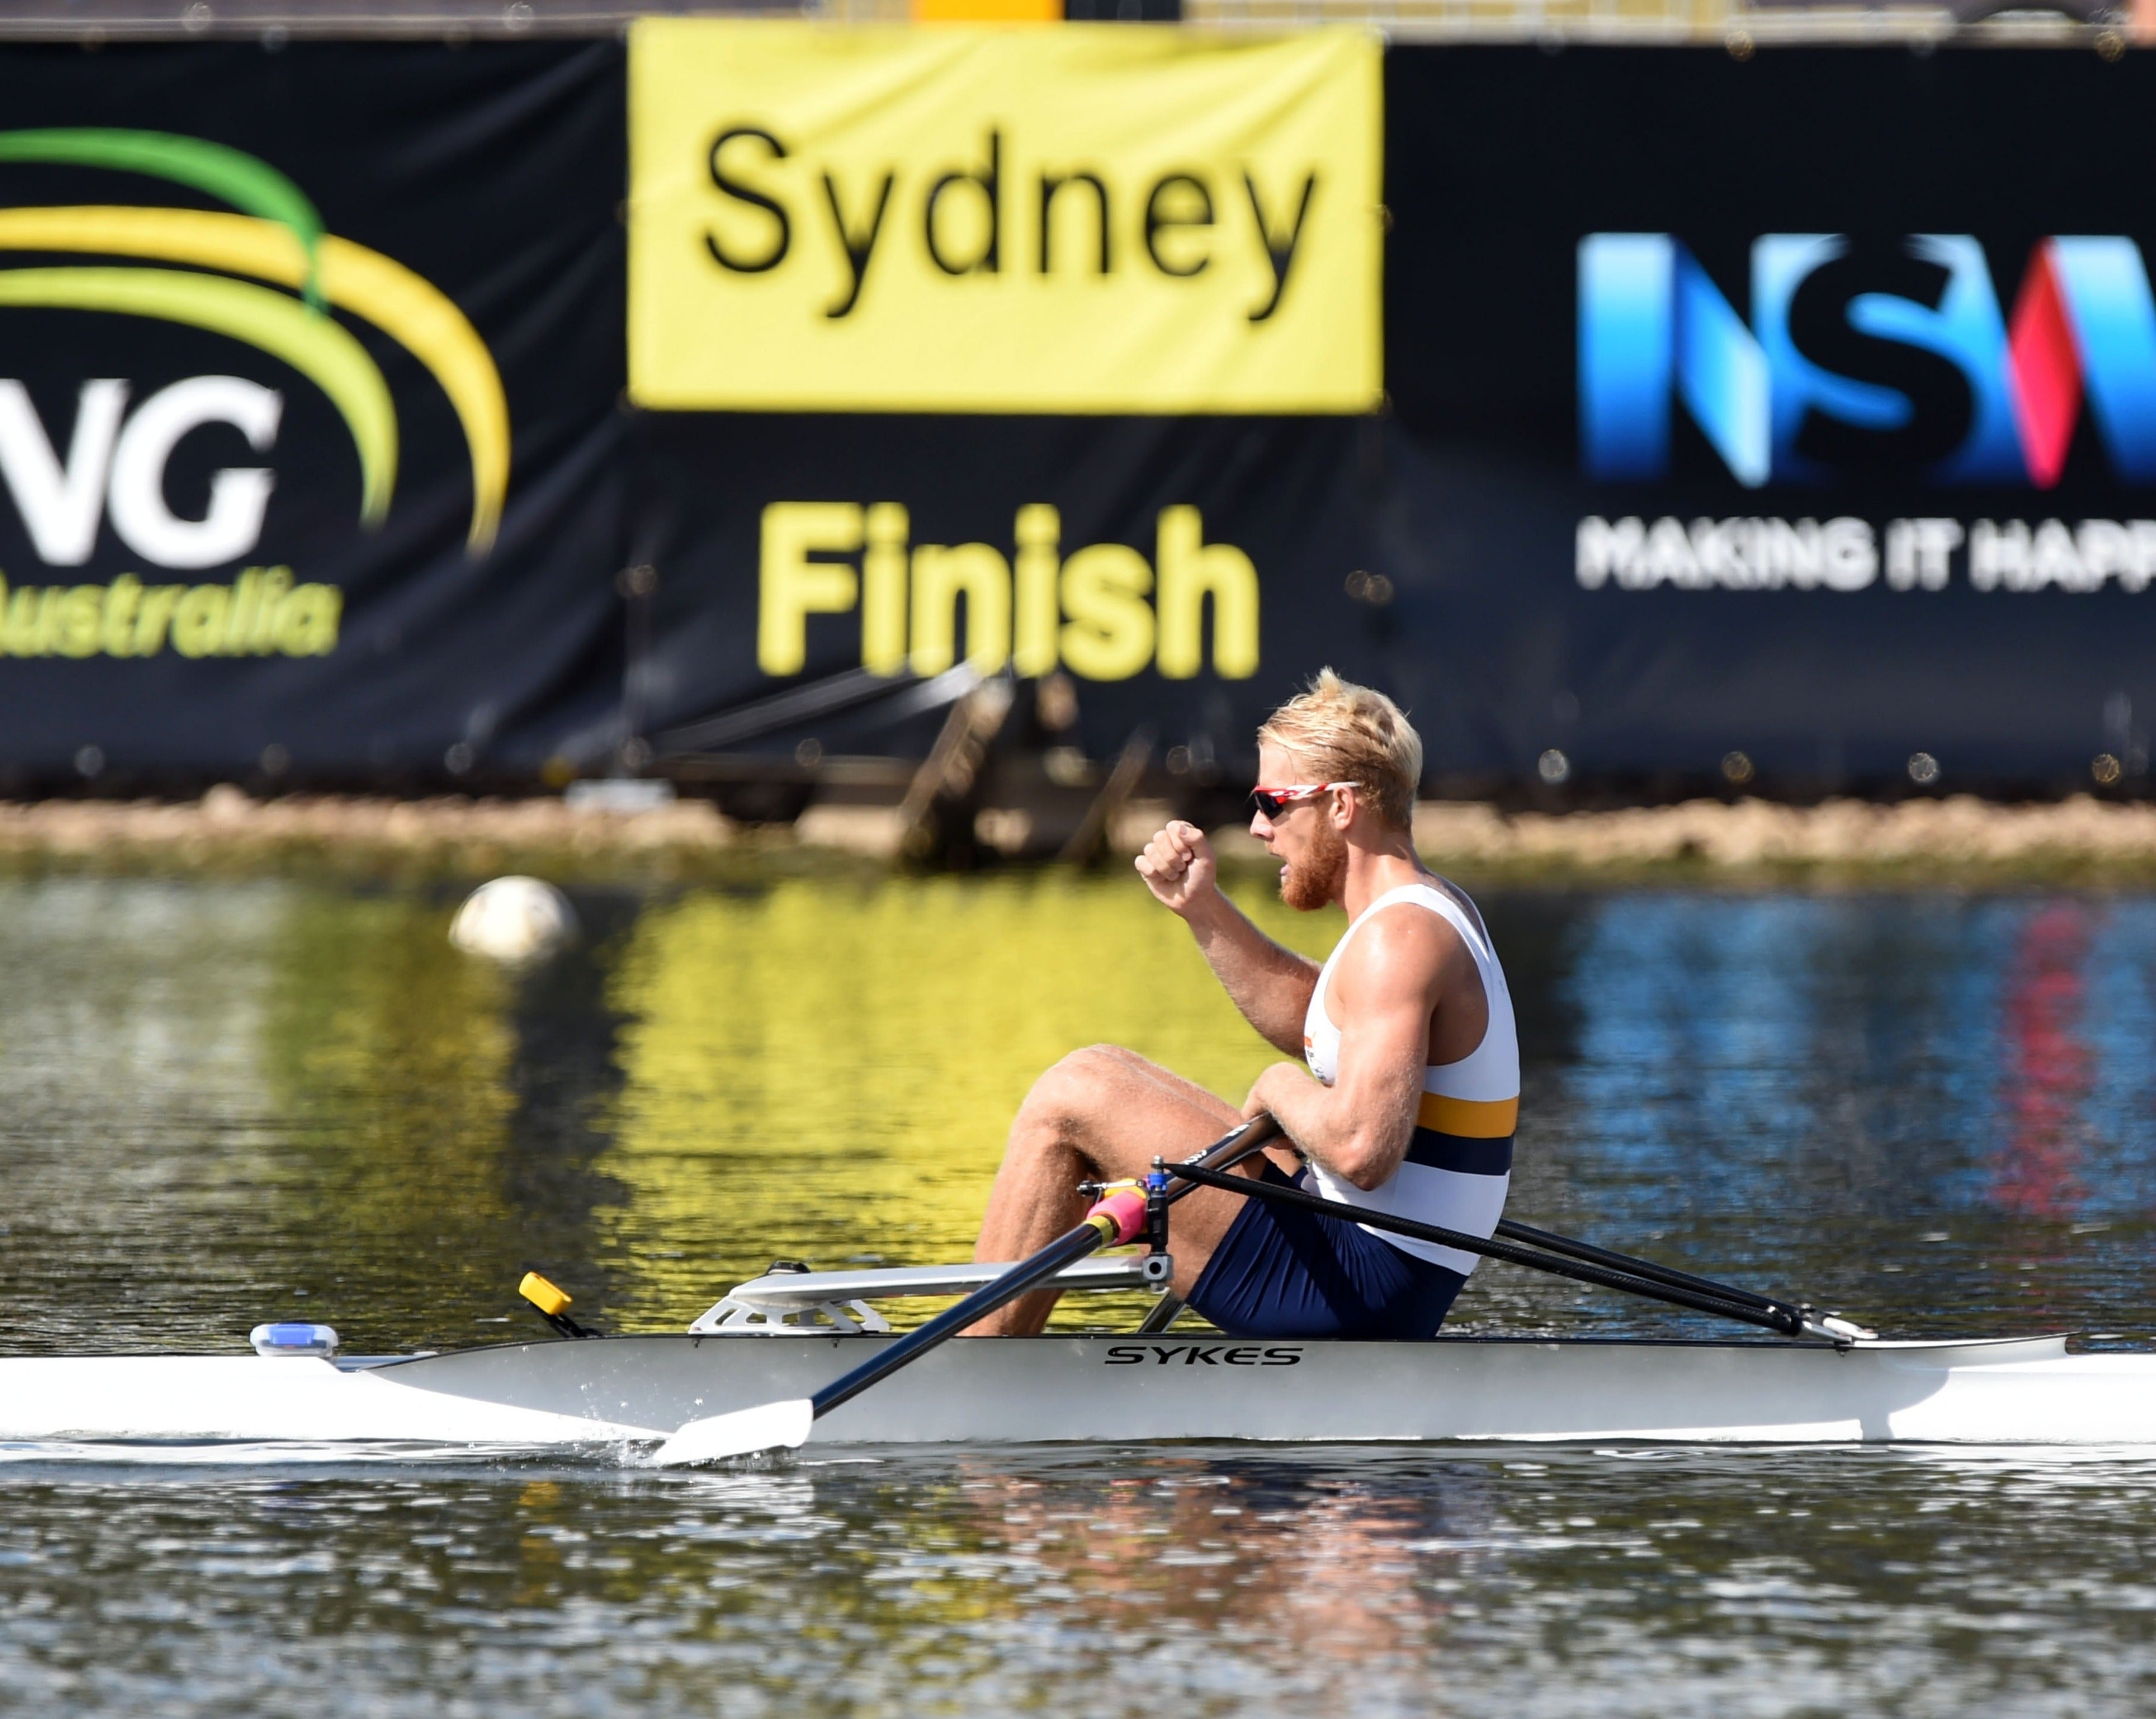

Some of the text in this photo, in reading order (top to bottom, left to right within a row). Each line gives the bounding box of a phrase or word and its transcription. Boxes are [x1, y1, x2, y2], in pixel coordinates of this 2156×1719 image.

[703, 125, 1317, 323] Sydney
[757, 502, 1261, 681] Finish
[1575, 515, 1880, 590] MAKING
[1884, 517, 1965, 591] IT
[0, 565, 342, 659] ustralia
[1104, 1346, 1304, 1366] SYKES
